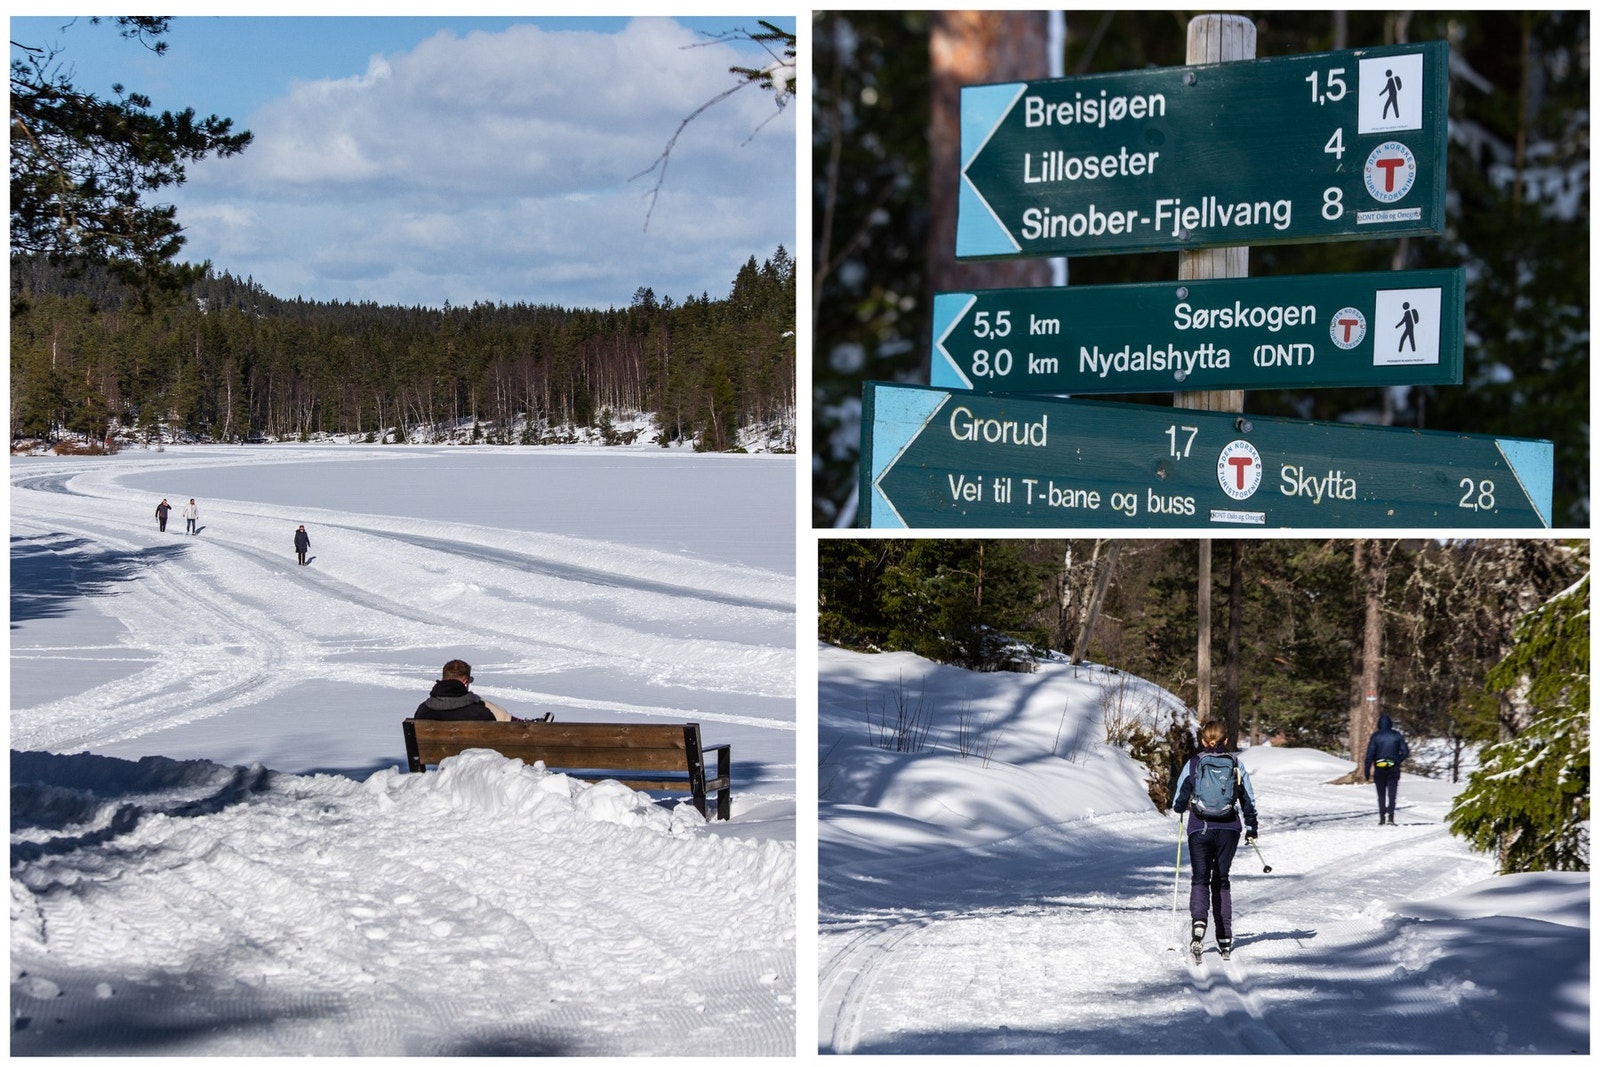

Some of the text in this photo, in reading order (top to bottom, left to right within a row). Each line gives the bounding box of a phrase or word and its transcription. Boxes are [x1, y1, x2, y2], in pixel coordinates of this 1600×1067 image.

[1024, 68, 1347, 129] Breisjøen 1,5
[1324, 127, 1346, 160] 4
[1368, 143, 1413, 165] DEN NORSKE
[1023, 146, 1160, 184] Lilloseter
[1376, 158, 1405, 193] T
[1366, 171, 1414, 201] TURISTFORENING
[1021, 187, 1344, 241] Sinober-Fjellvang 8
[973, 301, 1316, 340] 5,5 km Sørskogen
[1338, 319, 1359, 343] T
[972, 343, 1316, 379] 8,0 km Nydalshytta (DNT)
[949, 407, 1199, 461] Grorud 1,7
[1221, 442, 1260, 462] DEN NORSKE
[1228, 457, 1253, 490] T
[1280, 466, 1496, 511] Skytta 2,8
[948, 473, 1196, 517] Vei til T-bane og buss
